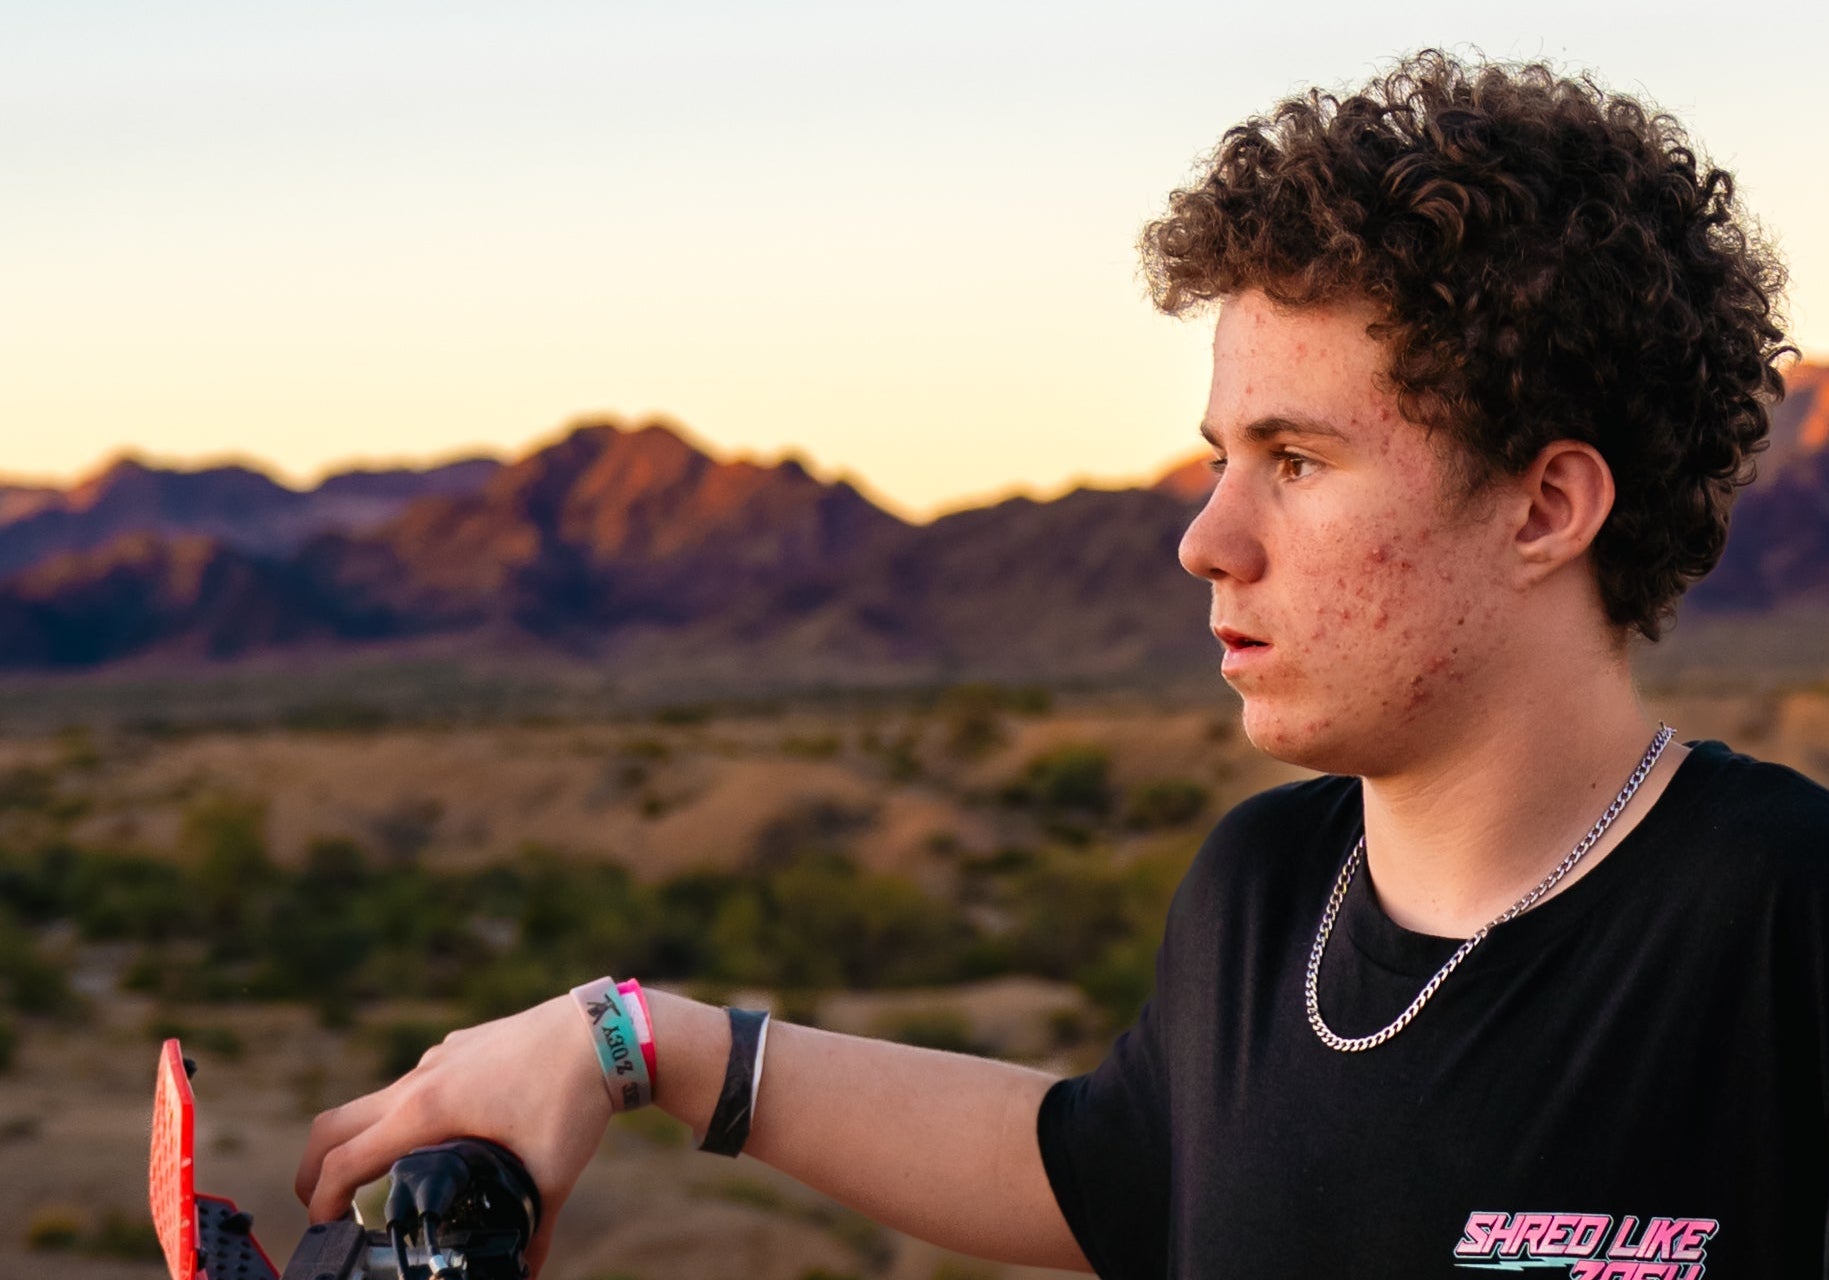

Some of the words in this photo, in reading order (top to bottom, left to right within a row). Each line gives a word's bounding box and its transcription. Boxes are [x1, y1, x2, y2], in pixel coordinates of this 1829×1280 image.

[602, 1026, 634, 1076] ZOEY
[1455, 1212, 1613, 1259] SHRED
[1607, 1215, 1719, 1263] LIKE
